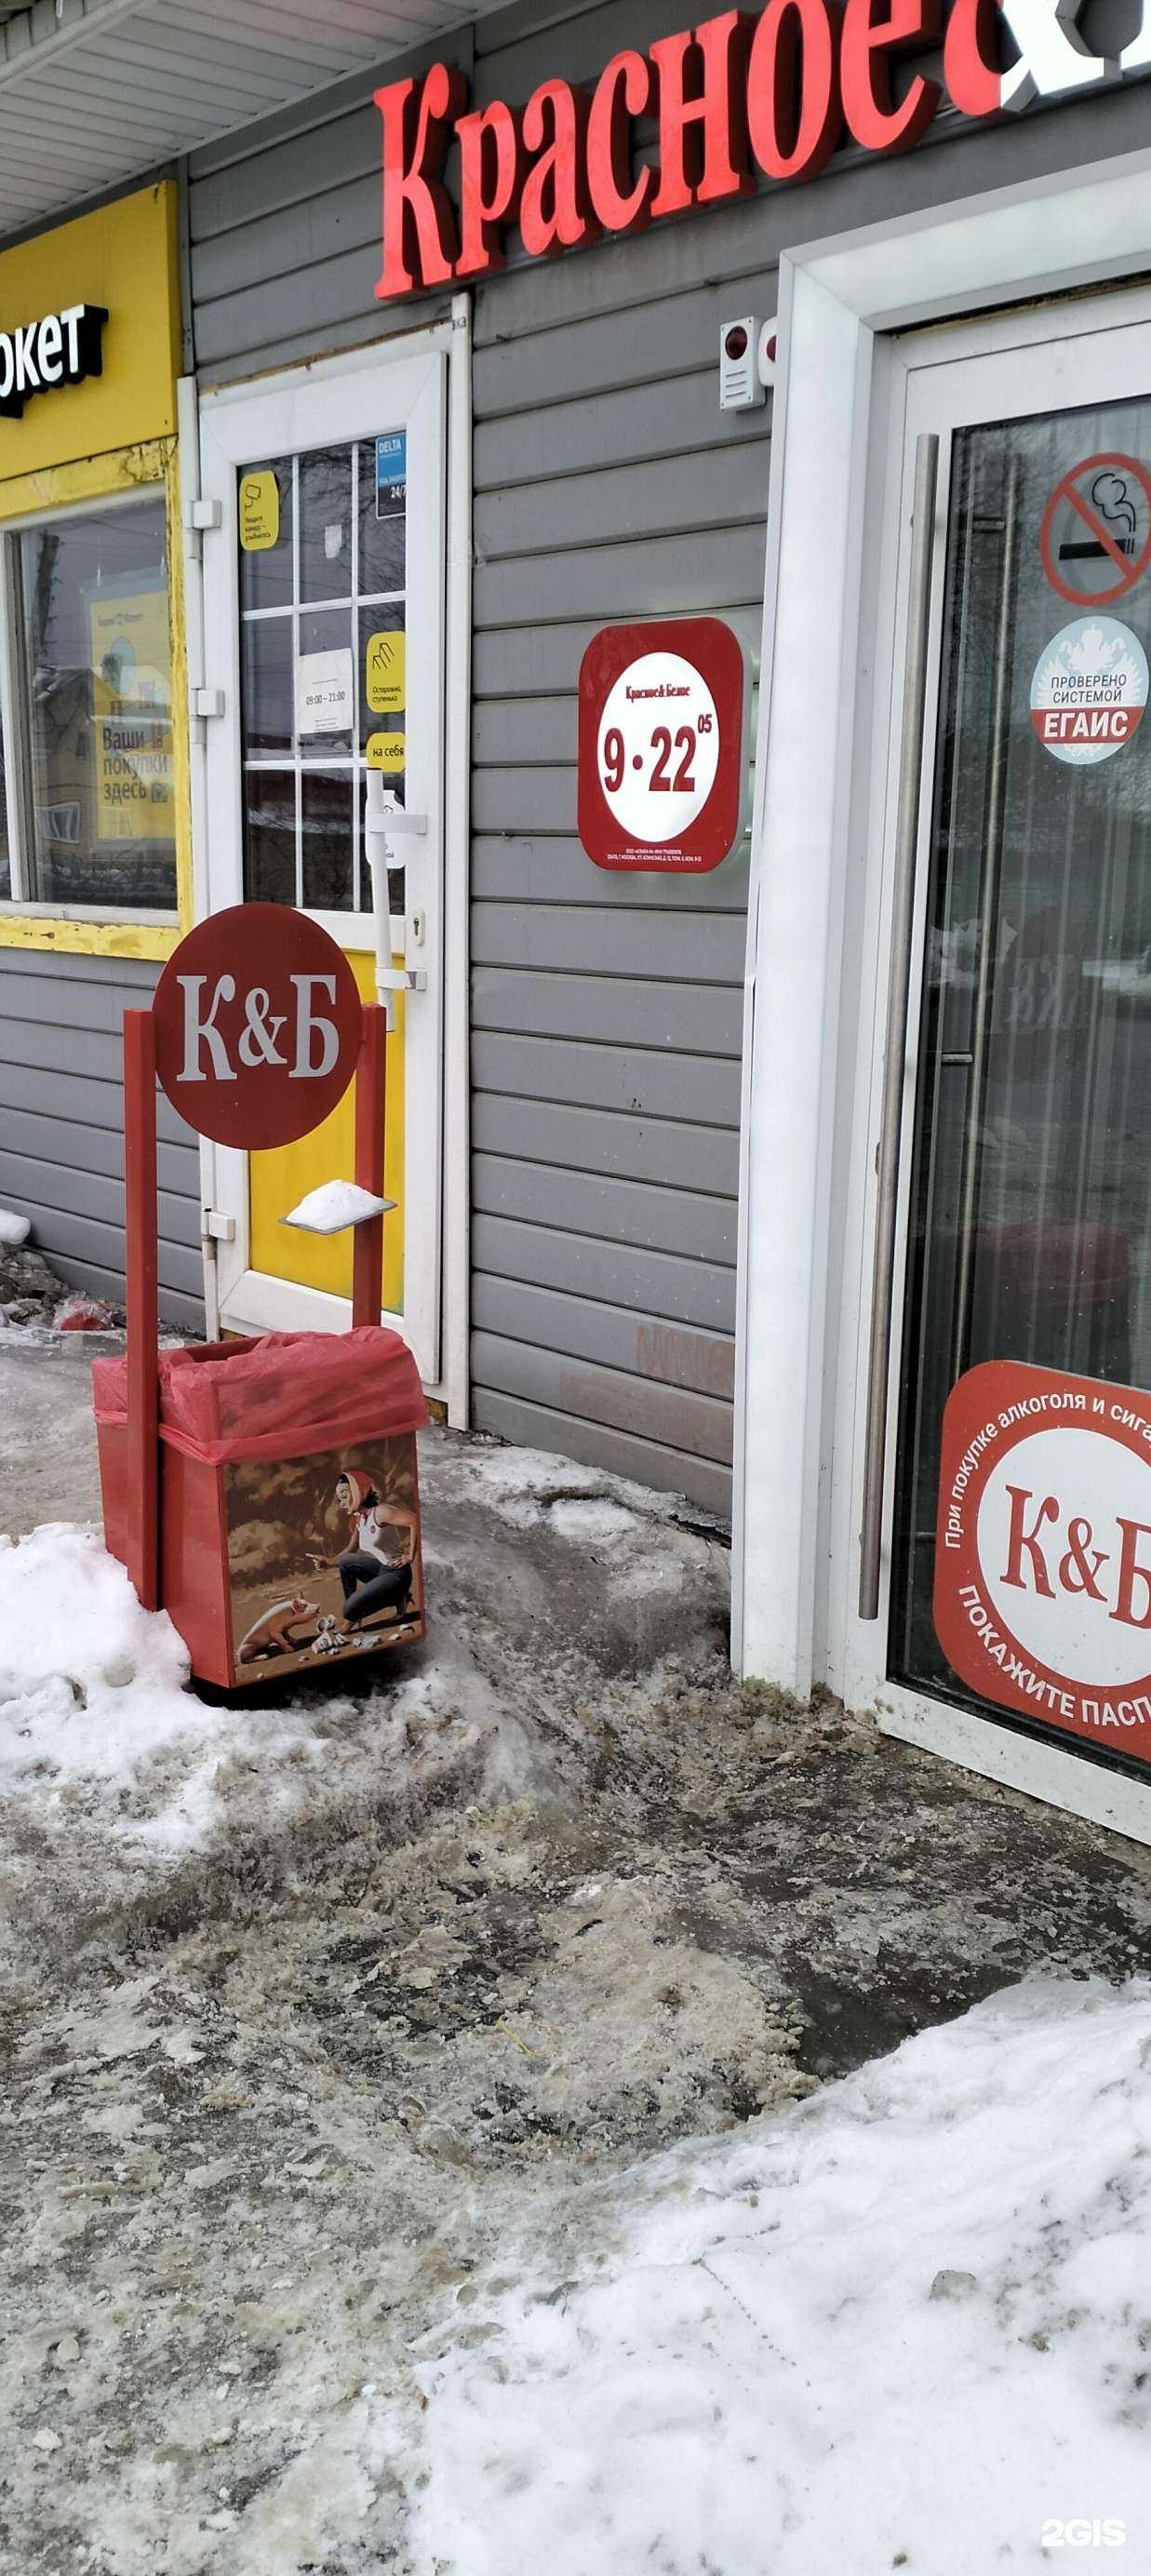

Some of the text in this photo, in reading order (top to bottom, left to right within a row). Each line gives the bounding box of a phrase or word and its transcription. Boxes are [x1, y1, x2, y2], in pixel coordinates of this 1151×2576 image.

[379, 438, 402, 454] DELTA
[1051, 674, 1127, 689] ПРОВЕРЕНО
[1053, 687, 1122, 704] СИСТЕМОЙ
[1043, 711, 1129, 738] ЕГАИС
[103, 726, 144, 751] Ваши
[372, 744, 404, 758] на себя
[104, 755, 167, 781] покупки
[104, 780, 146, 805] здесь
[177, 973, 340, 1081] К&Б
[997, 1393, 1087, 1429] алкоголя
[1092, 1397, 1105, 1415] и
[952, 1423, 998, 1501] покупке
[945, 1504, 964, 1549] При
[958, 1585, 1076, 1719] ПОКАЖИТЕ
